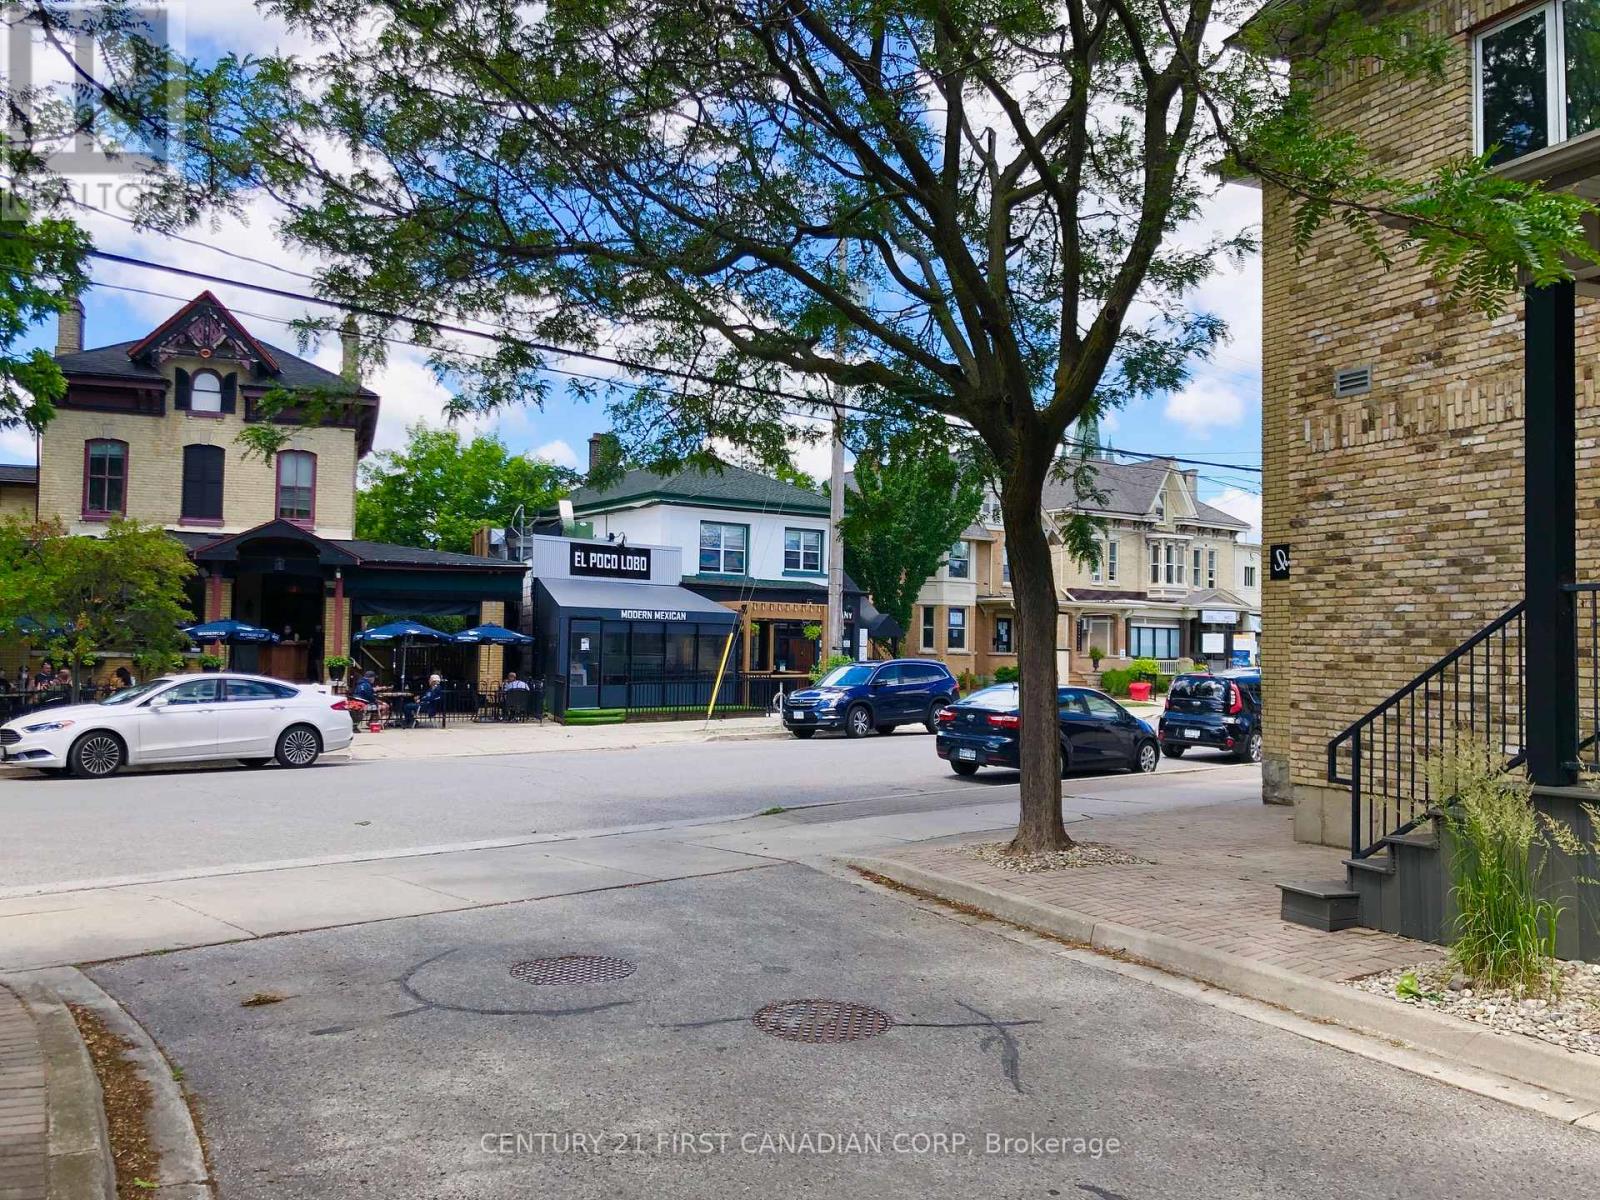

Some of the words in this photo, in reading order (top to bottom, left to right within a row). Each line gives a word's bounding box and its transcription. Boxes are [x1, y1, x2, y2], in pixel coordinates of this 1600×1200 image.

[574, 551, 588, 568] EL
[590, 552, 618, 569] POCO
[621, 554, 647, 571] LOBO
[621, 610, 653, 620] MODERN
[654, 610, 687, 621] MEXICAN
